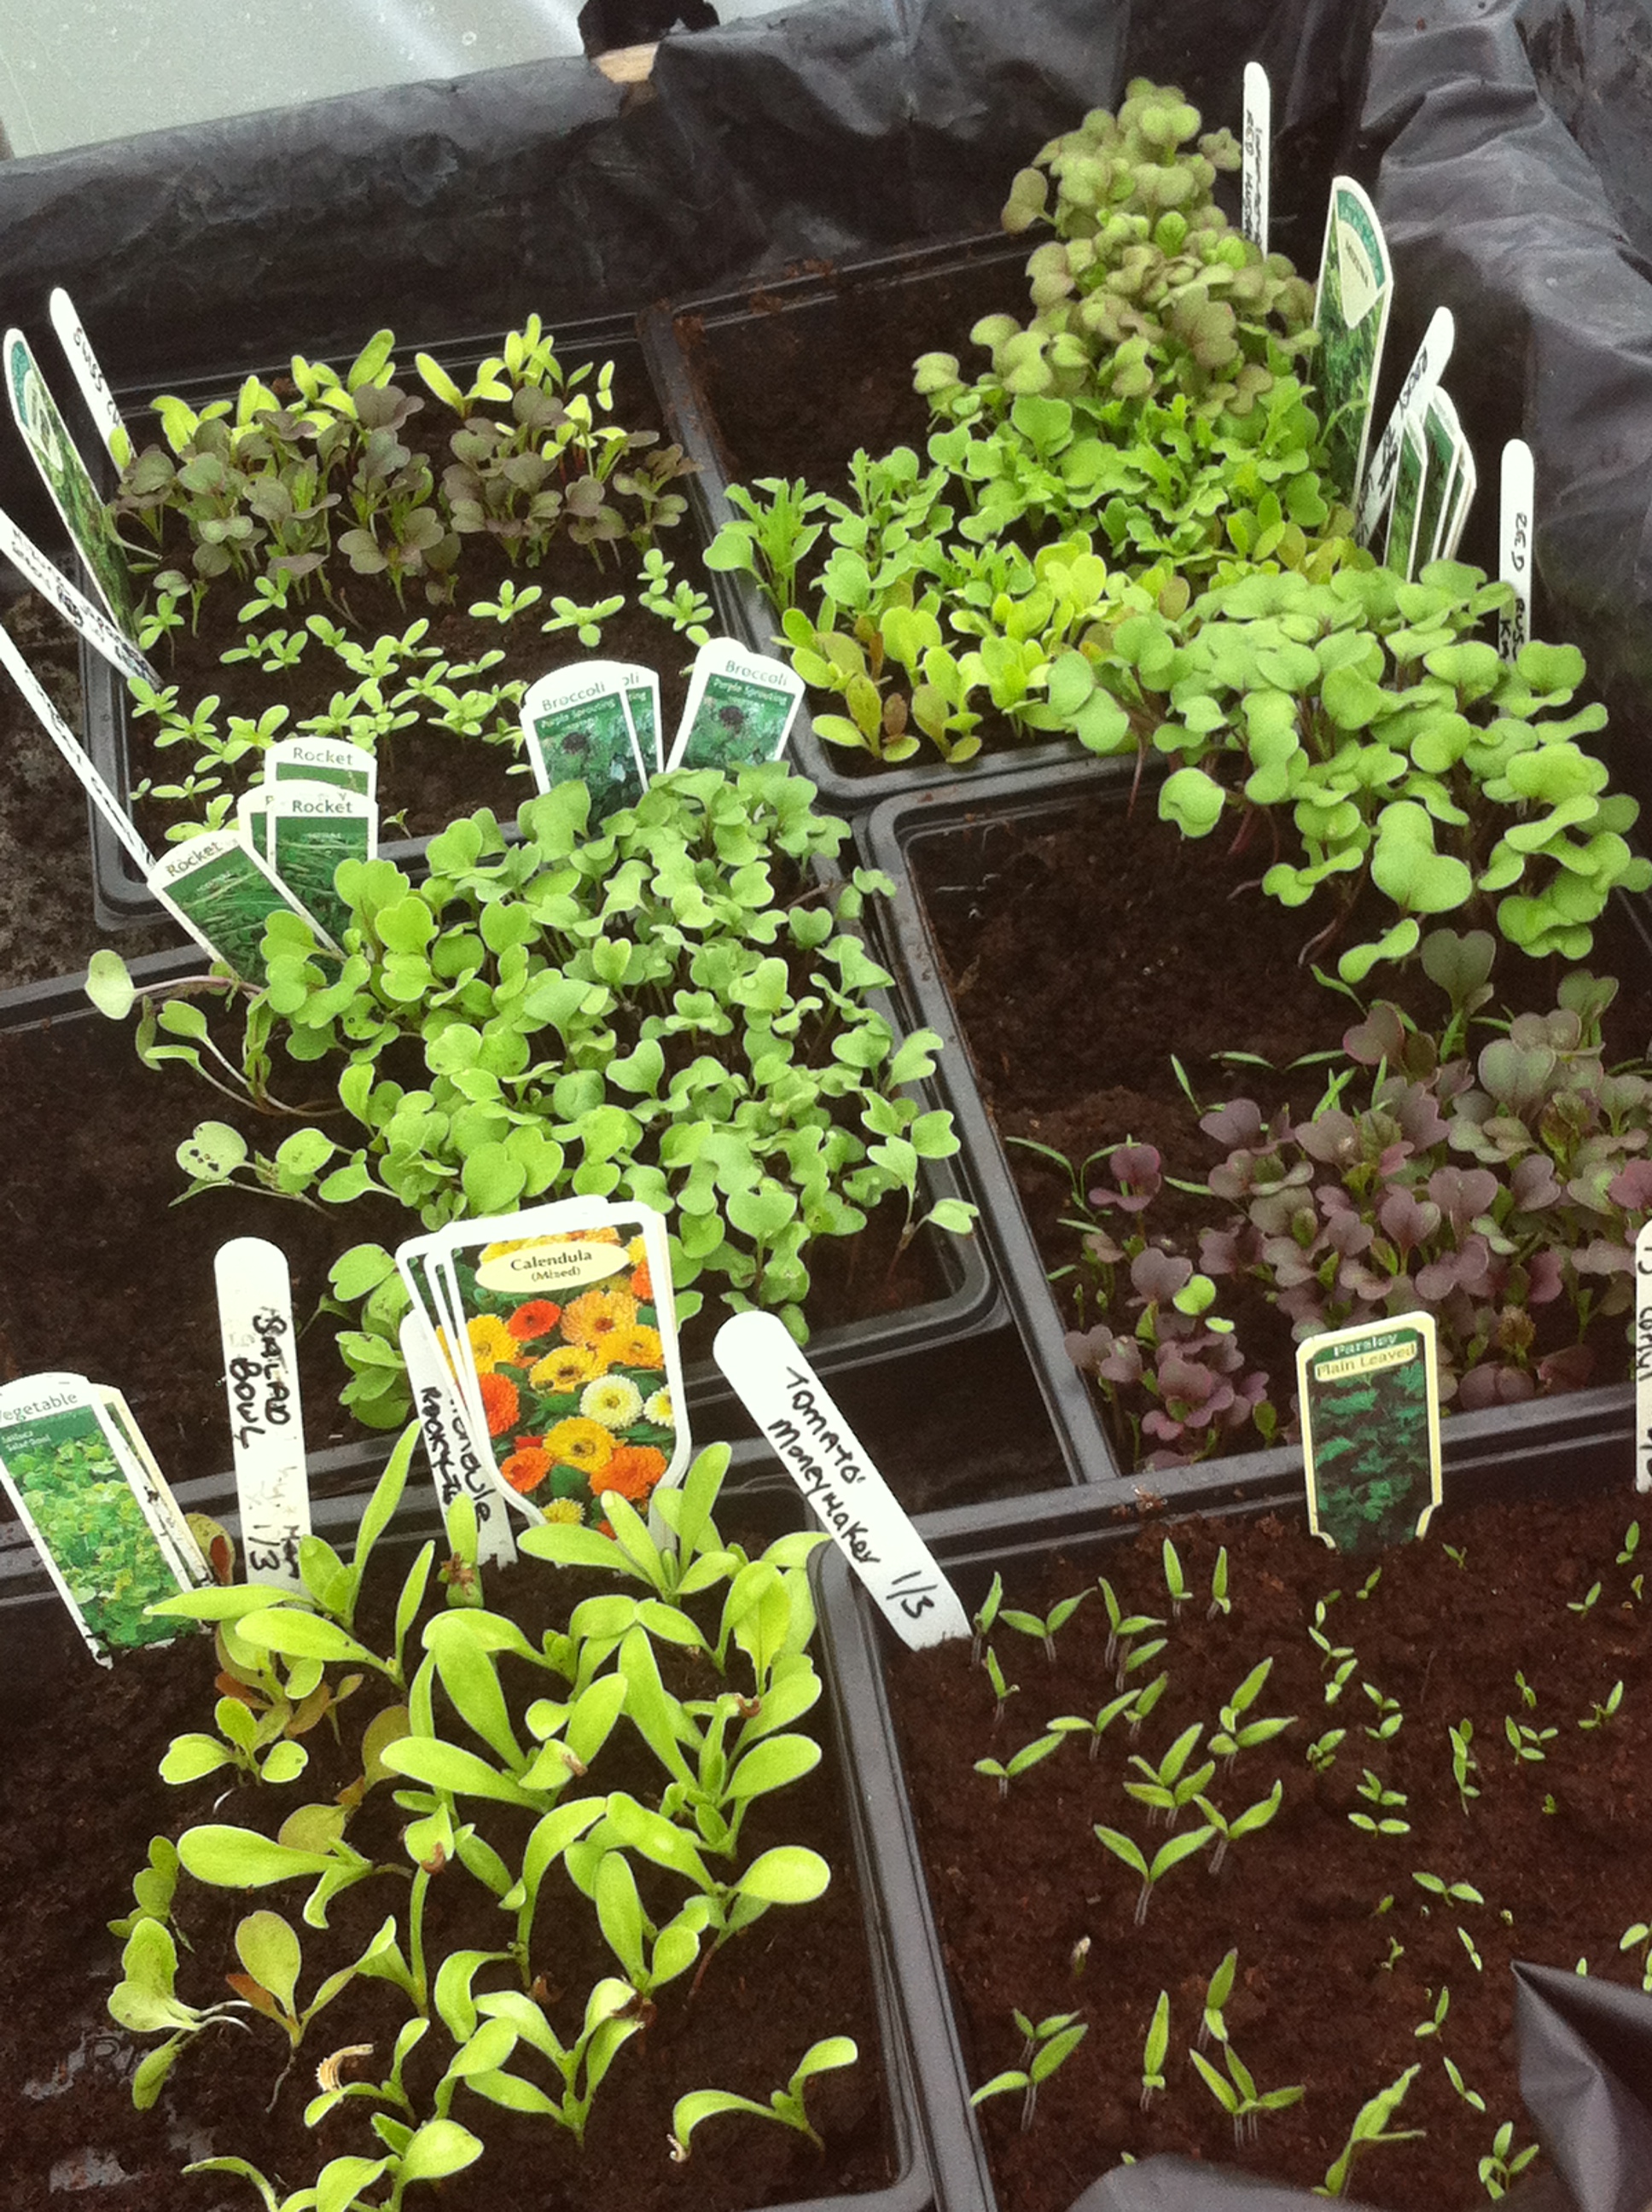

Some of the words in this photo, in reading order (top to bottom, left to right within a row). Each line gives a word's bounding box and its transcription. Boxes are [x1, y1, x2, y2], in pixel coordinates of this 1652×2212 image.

[713, 677, 743, 693] Purple
[724, 659, 788, 686] Broccoli
[541, 680, 607, 713] Broccoli
[293, 747, 353, 765] Rocket
[292, 800, 352, 813] Rocket
[165, 841, 224, 877] Rocket
[510, 1249, 593, 1272] Calendula
[531, 1266, 581, 1283] (Mixed)
[1316, 1360, 1356, 1378] Plain
[1359, 1342, 1416, 1367] Leaved
[1333, 1333, 1399, 1358] Parsley
[252, 1314, 292, 1426] SALAD
[229, 1356, 266, 1449] BOWL
[247, 1523, 282, 1572] 1/3
[886, 1569, 939, 1620] 1/3
